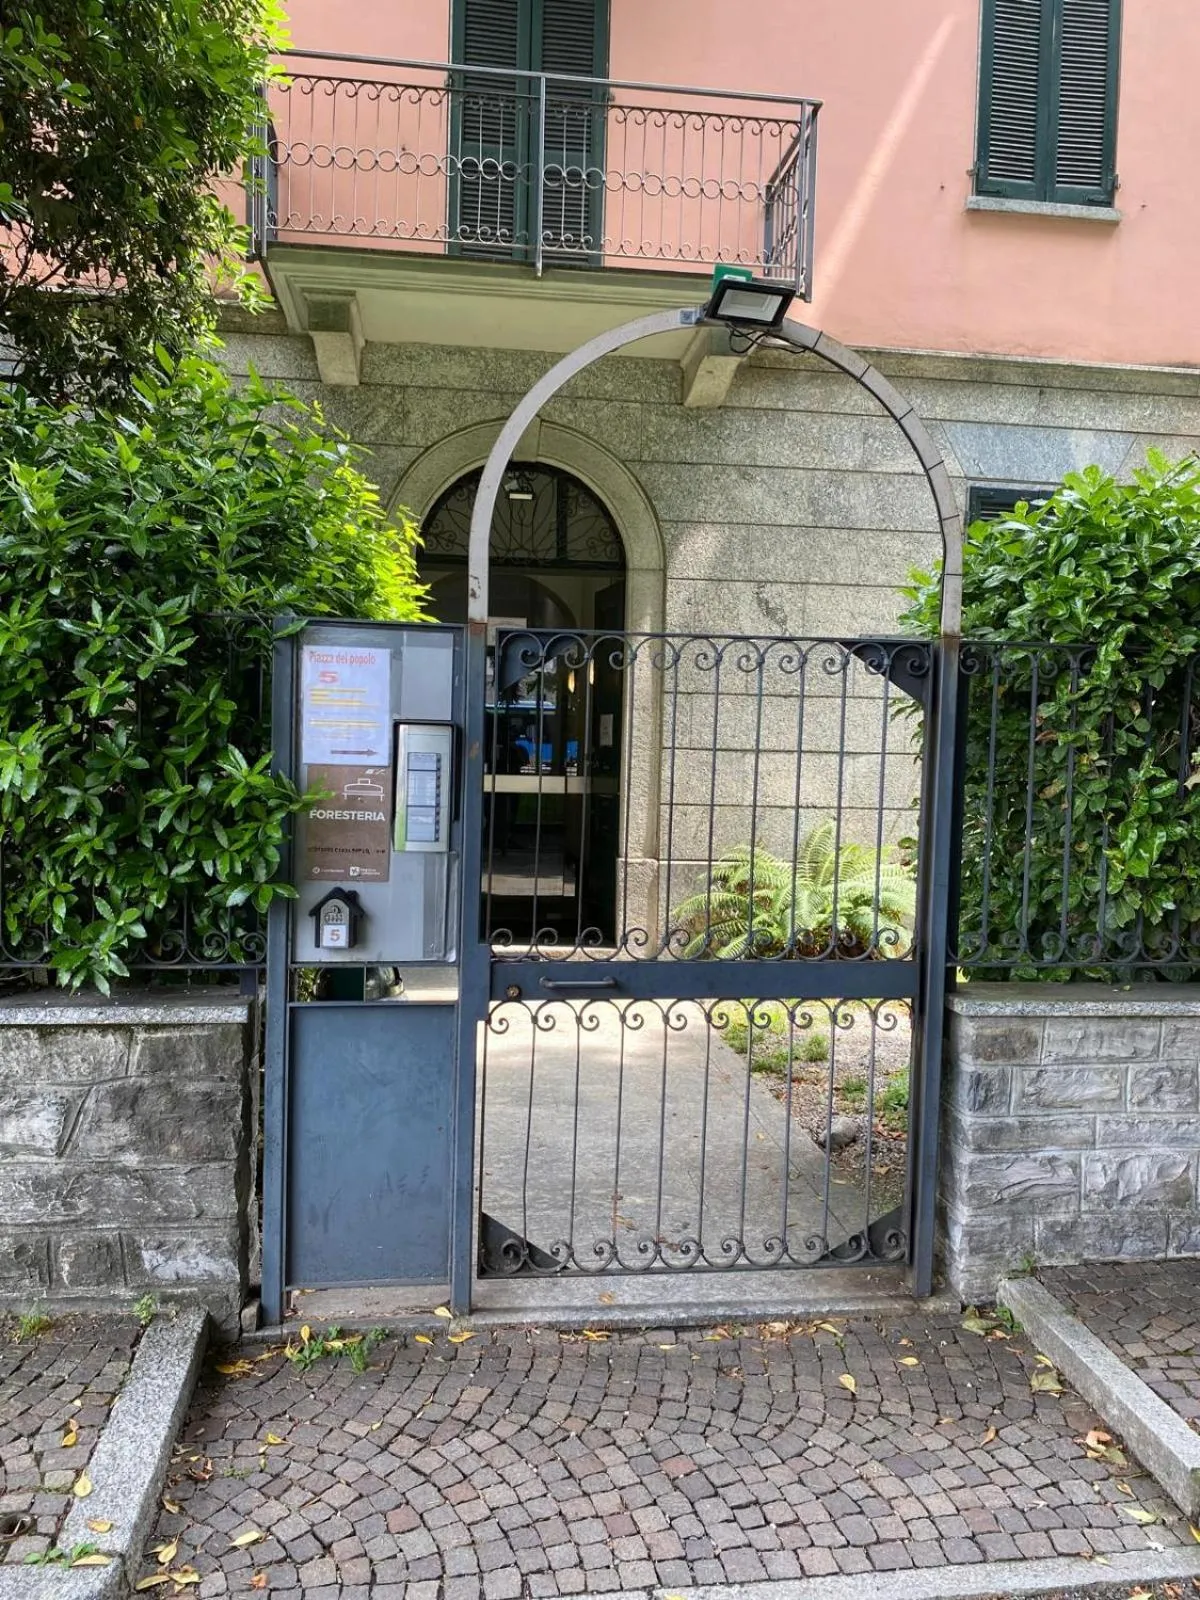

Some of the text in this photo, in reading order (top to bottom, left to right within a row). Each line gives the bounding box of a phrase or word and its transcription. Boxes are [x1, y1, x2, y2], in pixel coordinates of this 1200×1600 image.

[309, 651, 376, 667] Piazza del popolo
[309, 809, 385, 821] FORESTERIA
[330, 929, 340, 942] 5
